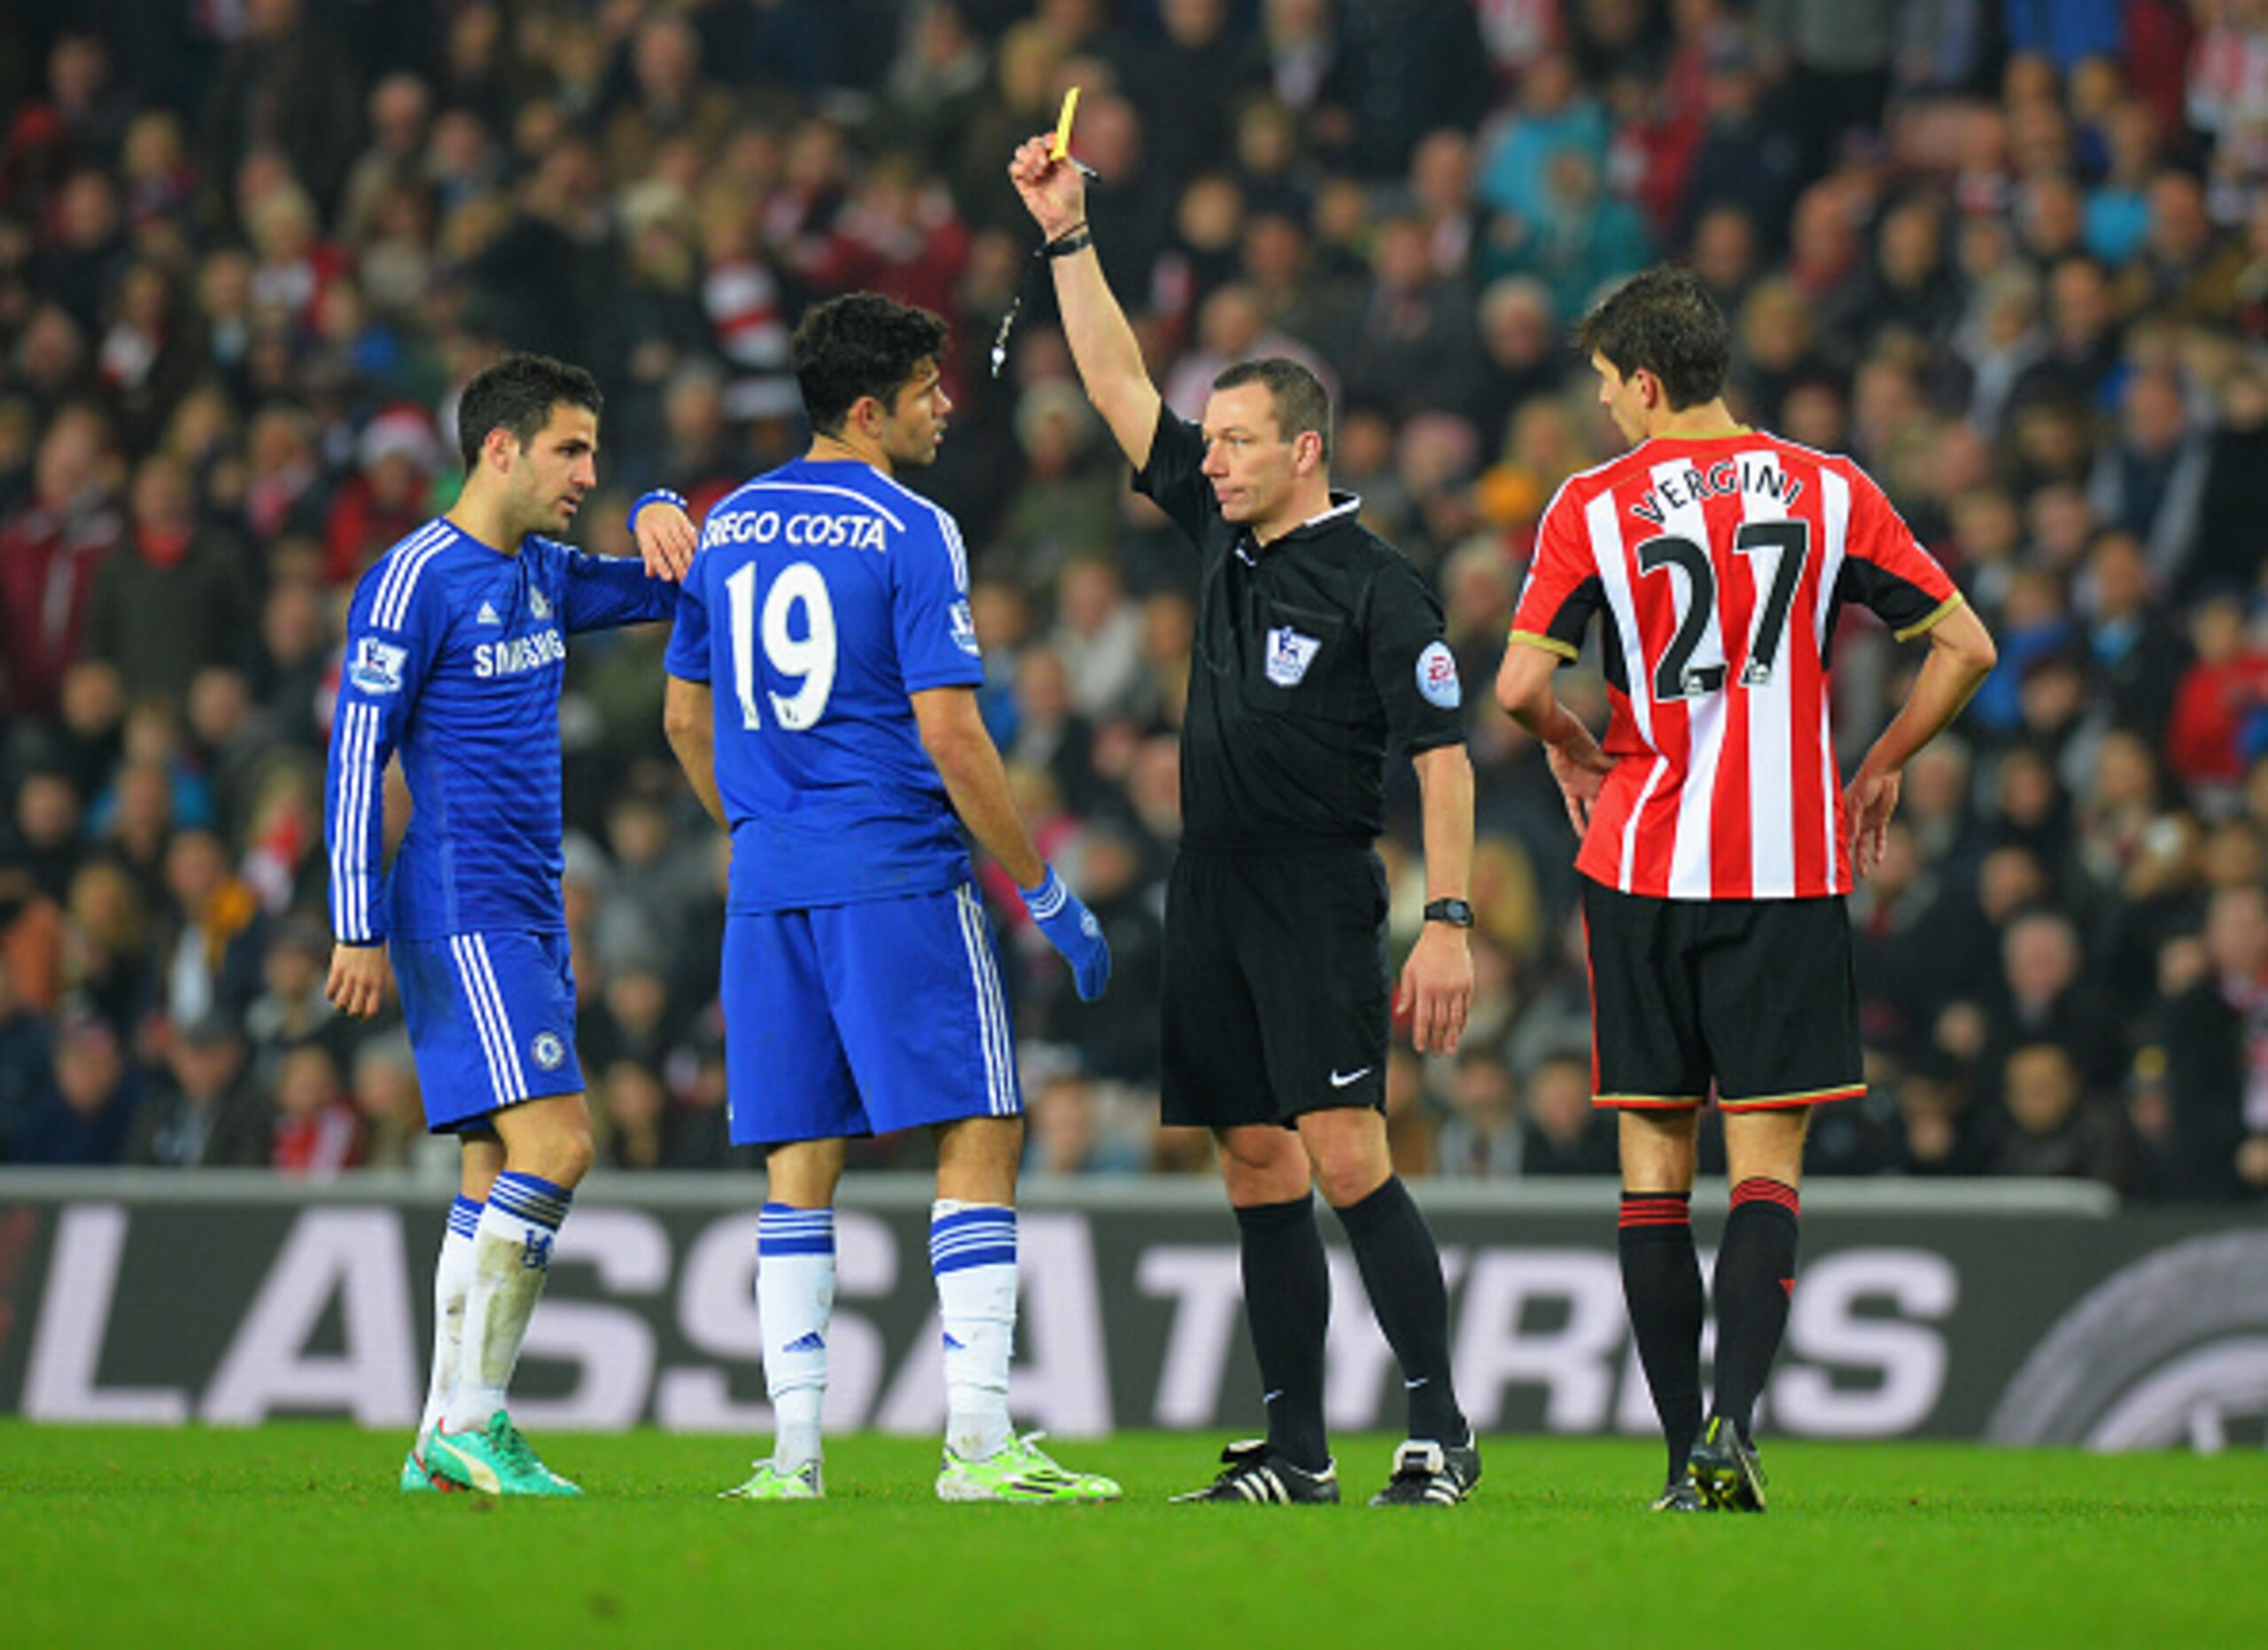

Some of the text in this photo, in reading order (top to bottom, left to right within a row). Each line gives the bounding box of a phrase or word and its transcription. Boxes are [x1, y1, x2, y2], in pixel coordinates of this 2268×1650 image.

[785, 513, 885, 552] COSTA
[1630, 461, 1804, 525] VERGINI
[725, 560, 838, 731] 19
[1635, 517, 1809, 703] 27
